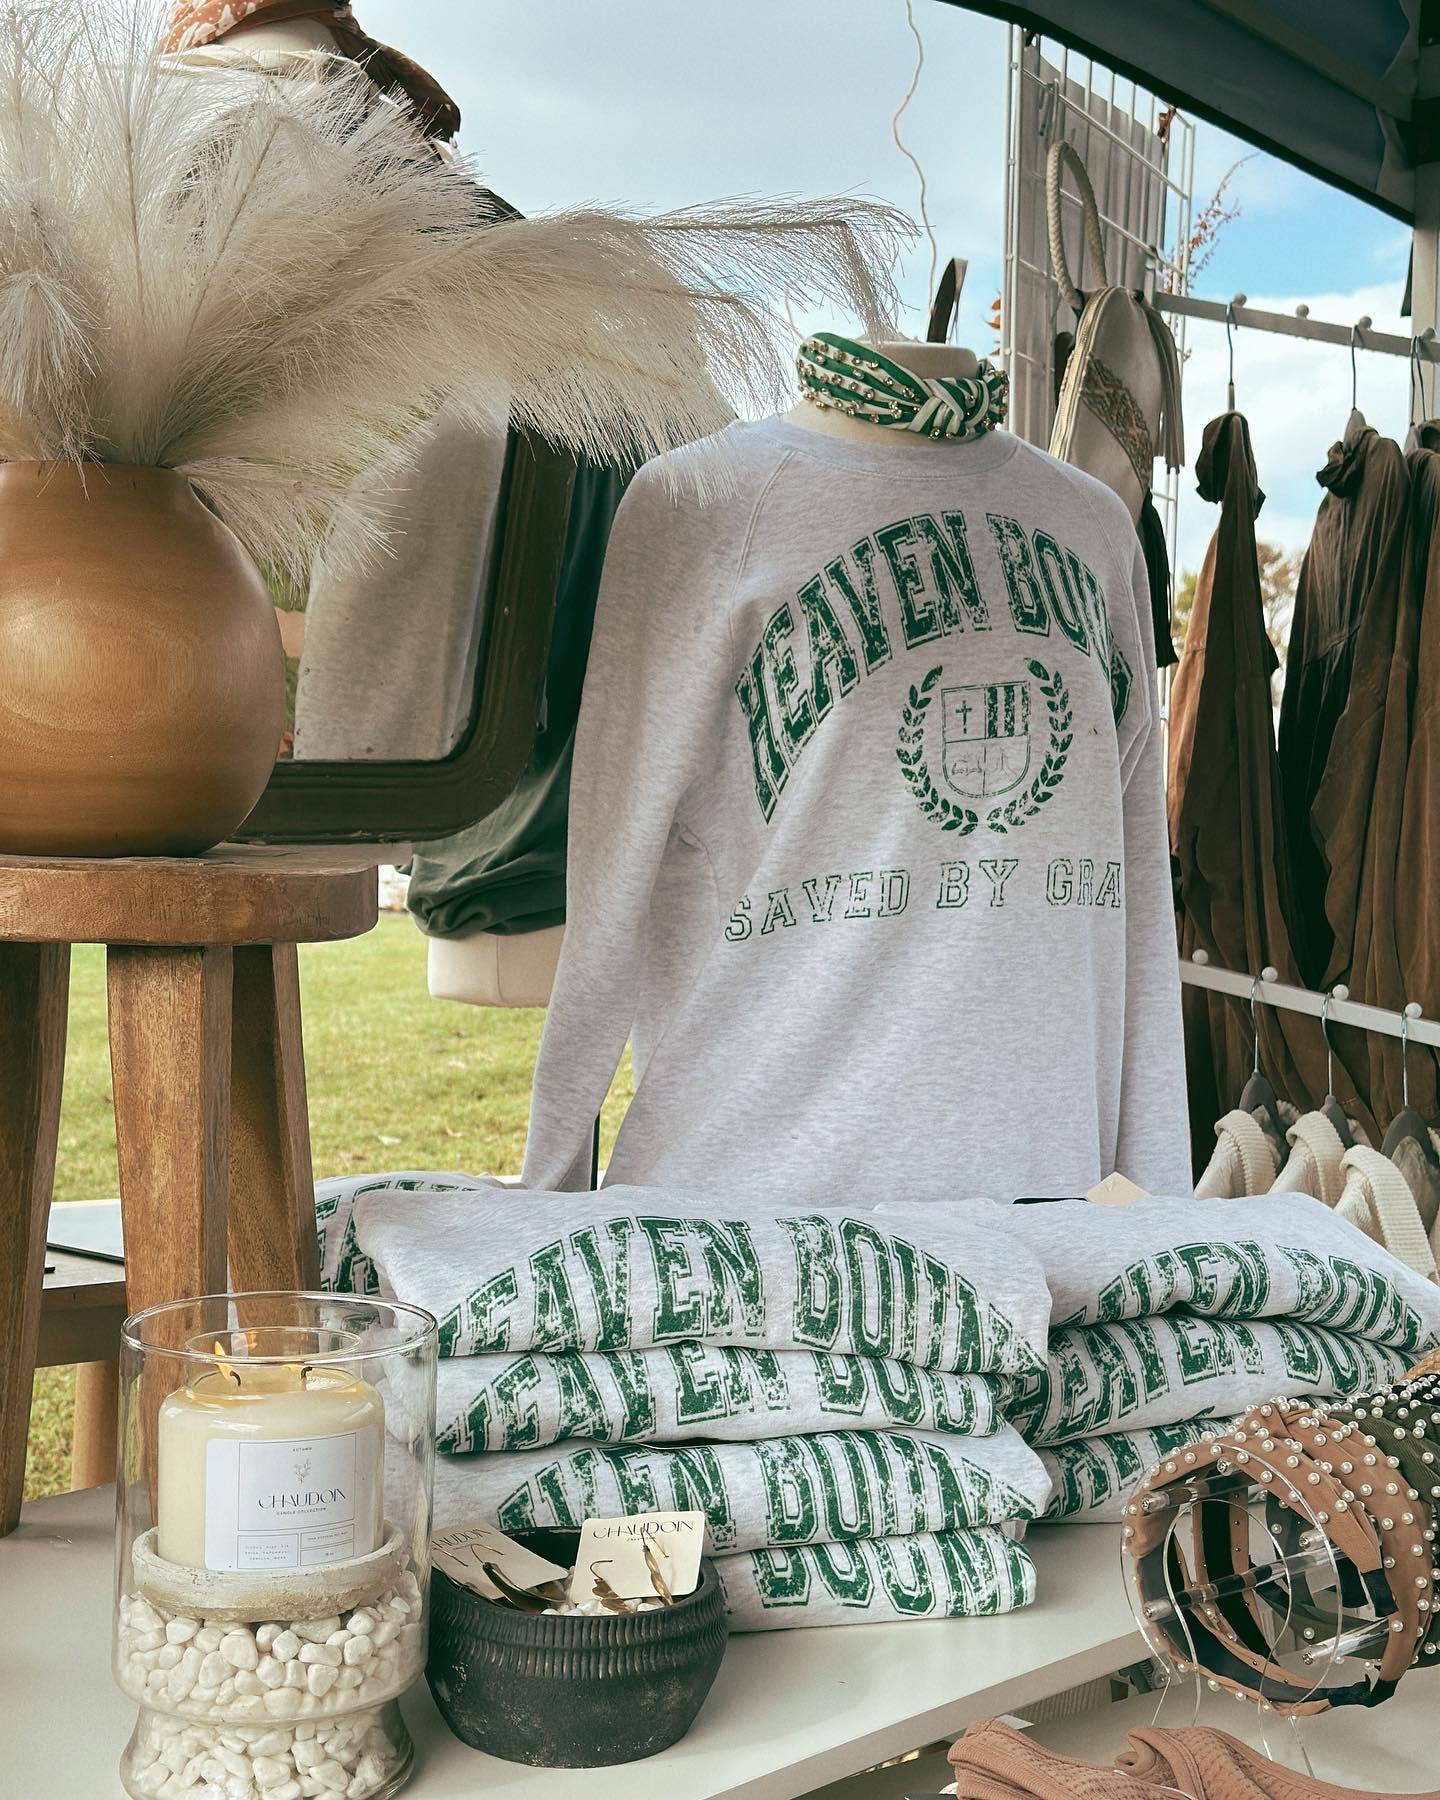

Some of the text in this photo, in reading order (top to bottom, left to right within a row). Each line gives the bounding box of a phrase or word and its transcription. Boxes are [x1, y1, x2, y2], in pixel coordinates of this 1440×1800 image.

[735, 509, 992, 826] HEAVEN
[724, 867, 911, 942] SAVED
[936, 858, 1019, 909] BY
[258, 1488, 346, 1509] CHAUDOIN
[592, 1519, 695, 1540] CHAUDOIN
